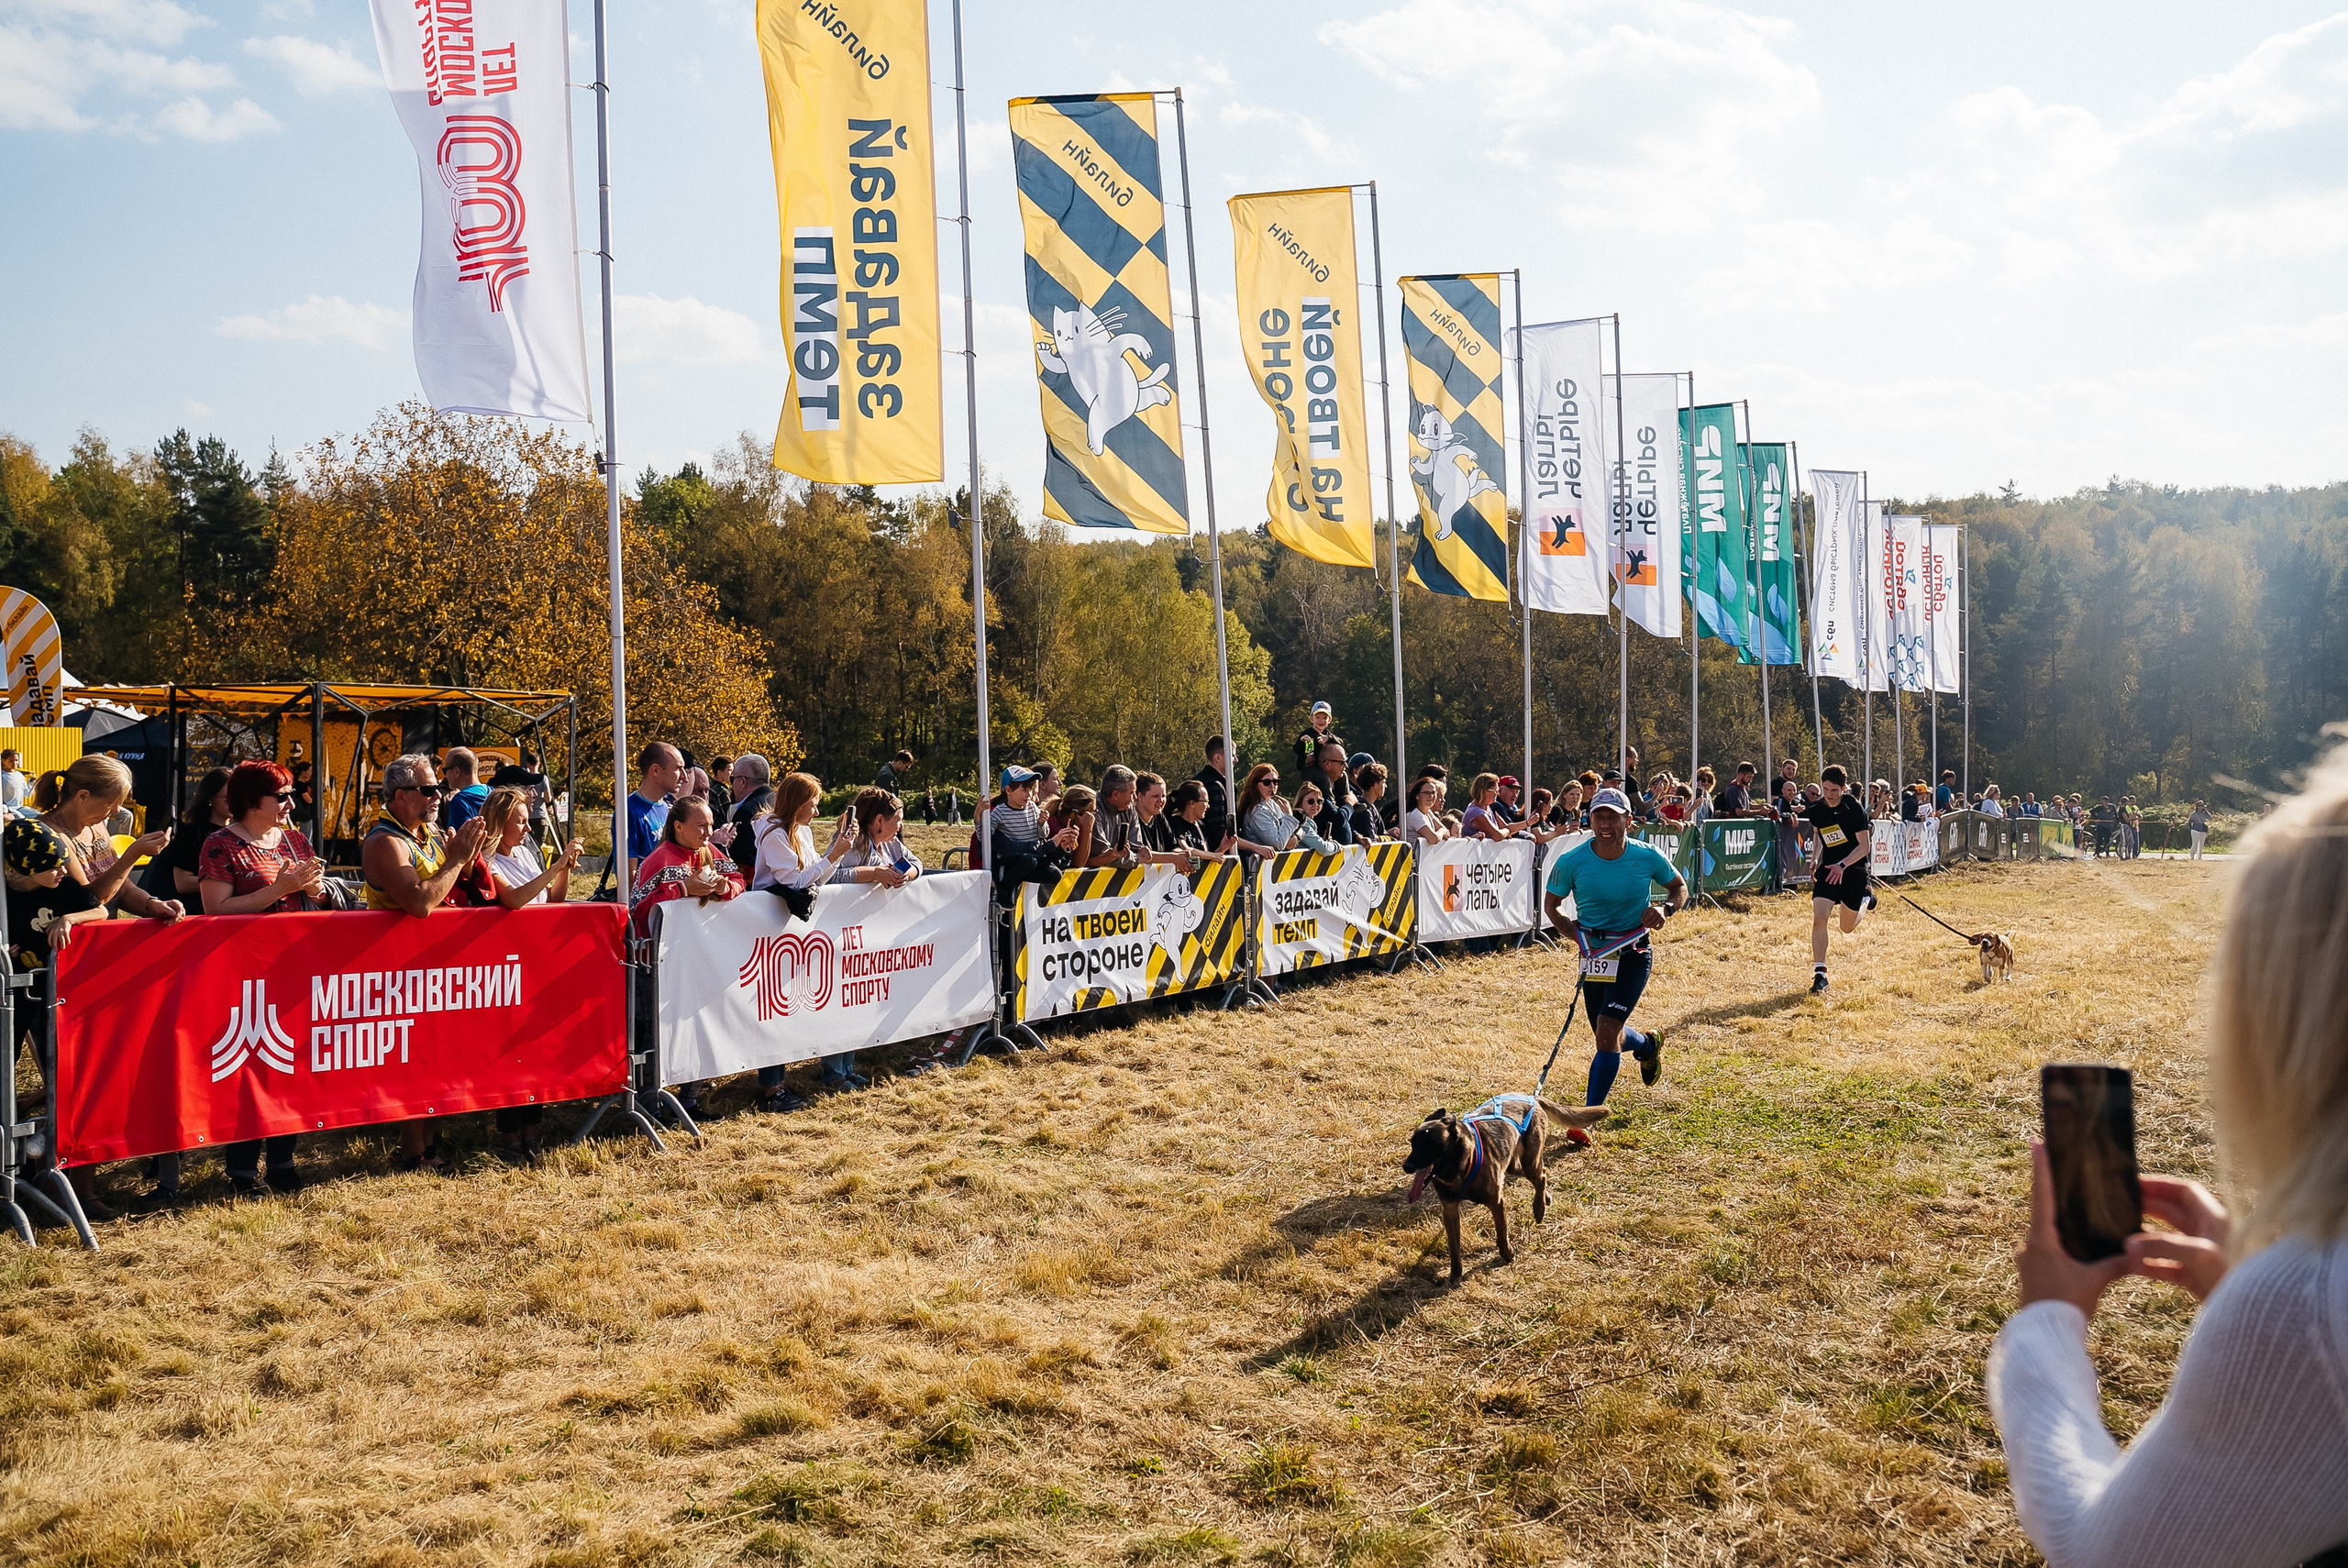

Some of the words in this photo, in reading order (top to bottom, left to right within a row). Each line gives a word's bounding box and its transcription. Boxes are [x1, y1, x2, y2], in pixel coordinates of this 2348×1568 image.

[8, 603, 30, 630] билайн
[41, 686, 55, 727] емп
[1648, 834, 1678, 862] МИР
[1725, 829, 1755, 856] МИР
[1826, 832, 1841, 843] 152
[1467, 863, 1512, 886] четыре
[1275, 881, 1339, 918] задавай
[1466, 889, 1501, 911] лапы
[841, 924, 863, 952] ЛЕТ
[1042, 916, 1072, 945] на
[1076, 900, 1145, 940] твоей
[1204, 903, 1227, 948] билайн
[1274, 919, 1317, 943] темп
[738, 930, 835, 1021] 100
[841, 944, 935, 979] МОСКОВСКОМУ
[1042, 942, 1144, 984] стороне
[1588, 961, 1609, 974] 159
[310, 954, 522, 1022] МОСКОВСКИЙ
[841, 977, 891, 1008] СПОРТУ
[310, 1019, 415, 1073] СПОРТ
